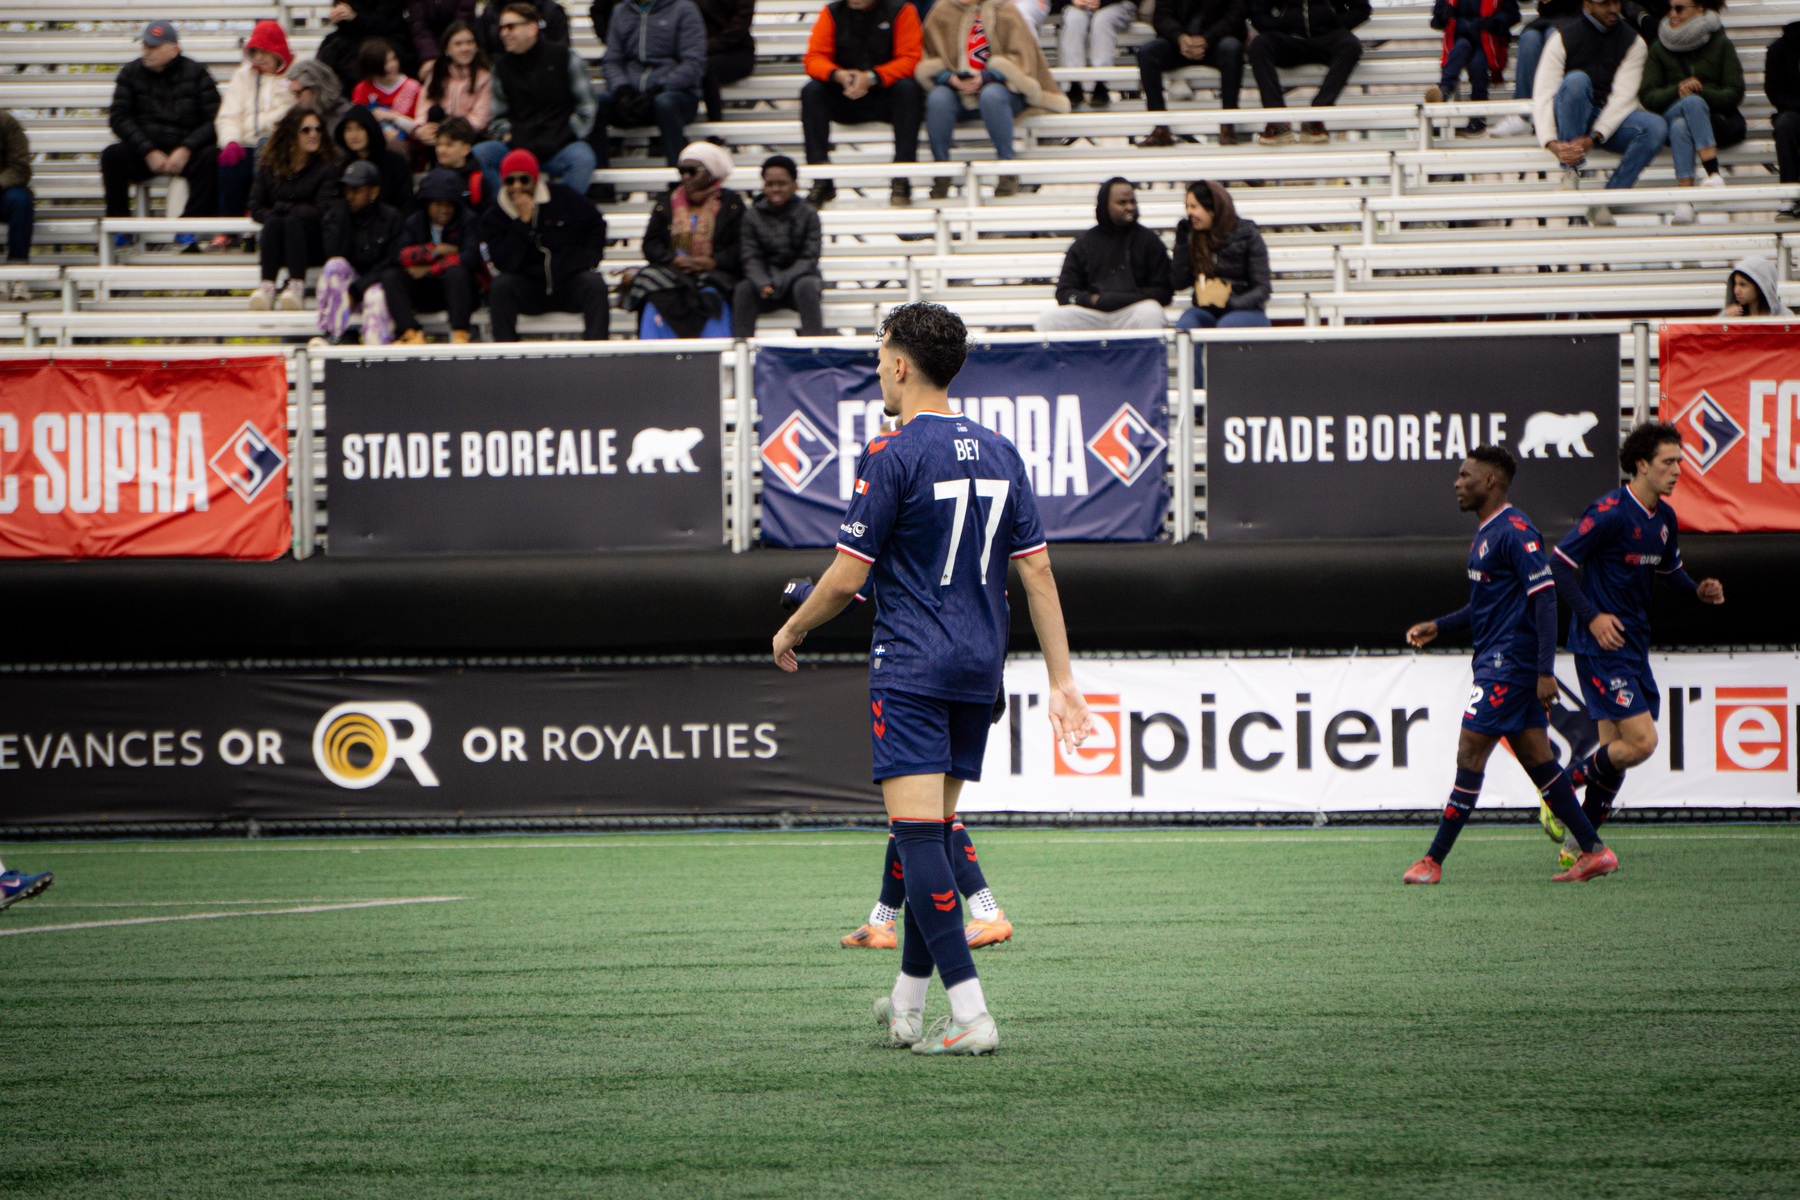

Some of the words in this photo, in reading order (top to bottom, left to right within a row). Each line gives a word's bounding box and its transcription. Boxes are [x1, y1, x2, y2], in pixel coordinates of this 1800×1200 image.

[342, 432, 451, 480] STADE
[461, 427, 618, 478] BORÉALE
[953, 438, 980, 462] BEY
[1224, 415, 1335, 464] STADE
[1748, 380, 1800, 484] FC
[33, 412, 209, 514] SUPRA
[933, 478, 1010, 586] 77
[0, 730, 204, 770] EVANCES
[218, 728, 285, 766] OR
[462, 726, 529, 764] OR
[542, 722, 779, 763] ROYALTIES
